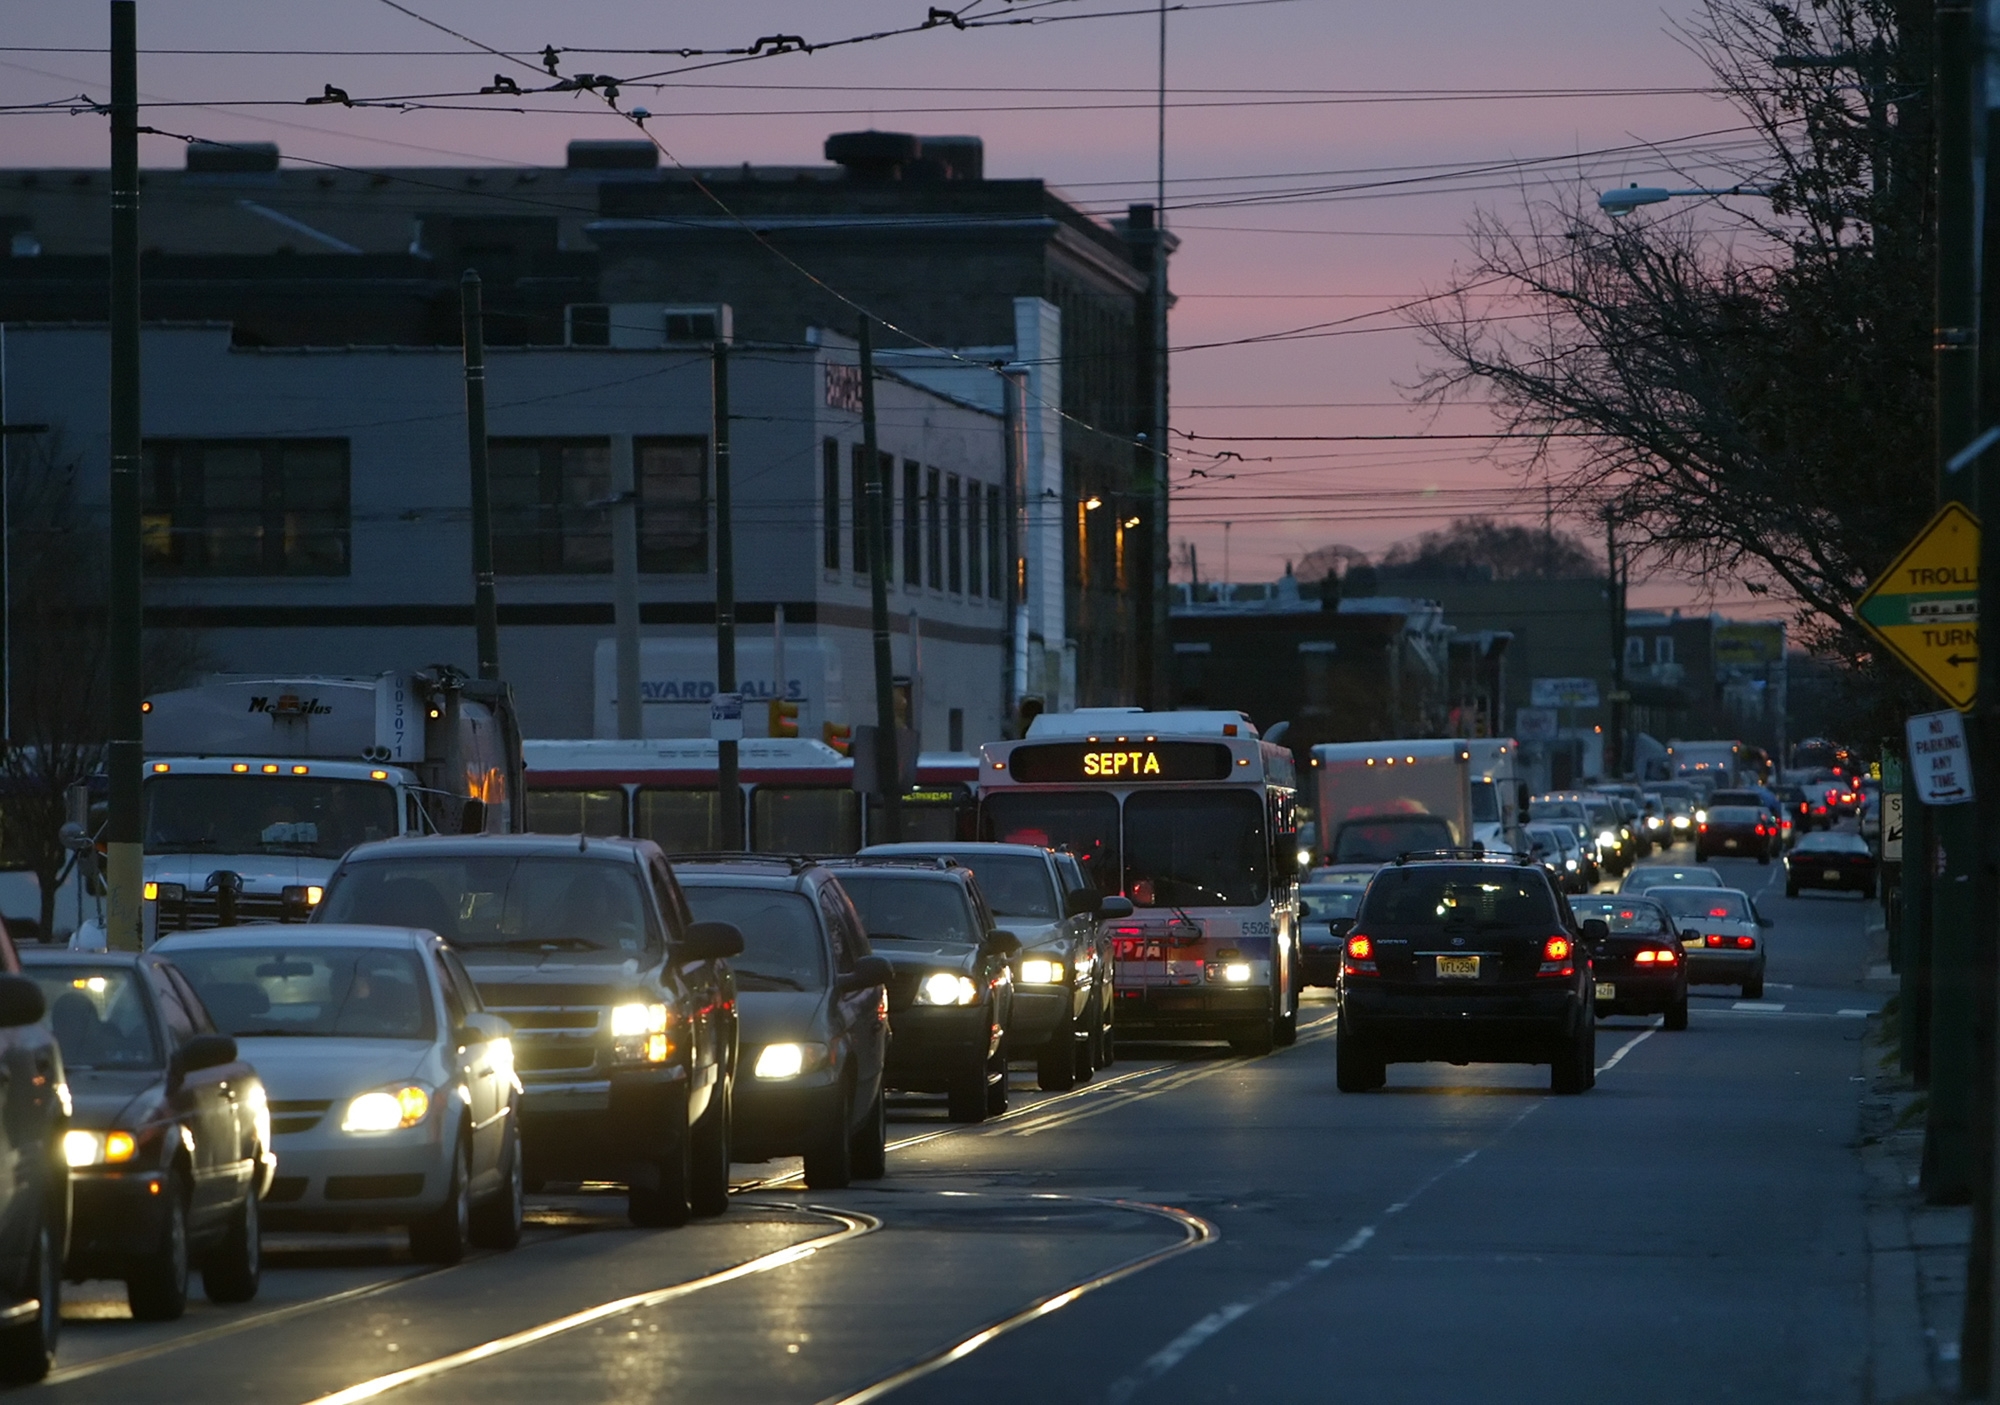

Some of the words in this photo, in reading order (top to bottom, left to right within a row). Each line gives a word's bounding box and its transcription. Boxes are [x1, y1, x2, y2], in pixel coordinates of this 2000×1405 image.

[1908, 567, 1979, 585] TROLL
[641, 681, 717, 699] AYARD
[248, 696, 332, 714] Mcilus
[394, 676, 404, 758] 005071
[1929, 720, 1944, 734] NO
[1916, 735, 1961, 755] PARKING
[1083, 751, 1161, 775] SEPTA
[1932, 756, 1952, 770] ANY
[1930, 772, 1957, 788] TIME
[1242, 921, 1270, 935] 5526
